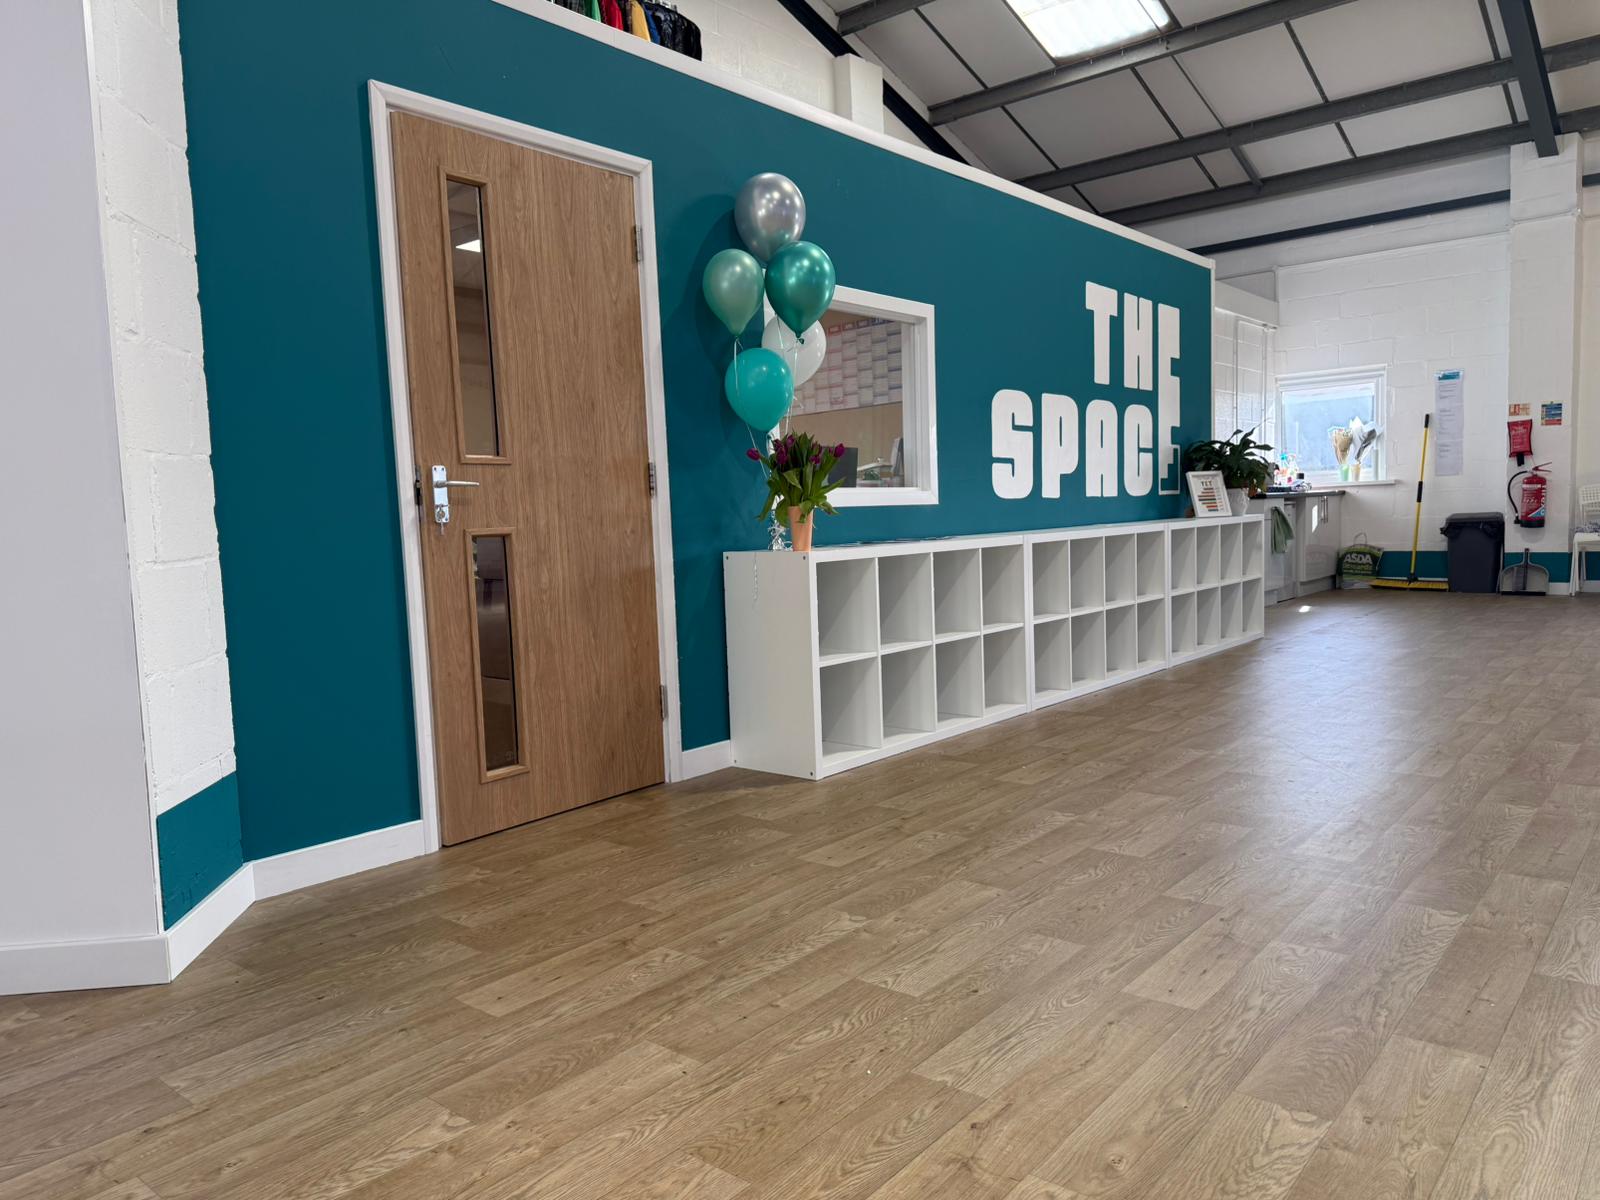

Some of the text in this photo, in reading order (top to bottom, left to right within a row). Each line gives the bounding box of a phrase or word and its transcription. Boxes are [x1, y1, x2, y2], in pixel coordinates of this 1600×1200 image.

[1085, 281, 1180, 405] THE
[991, 386, 1180, 499] SPACE
[1343, 553, 1373, 564] ASDA
